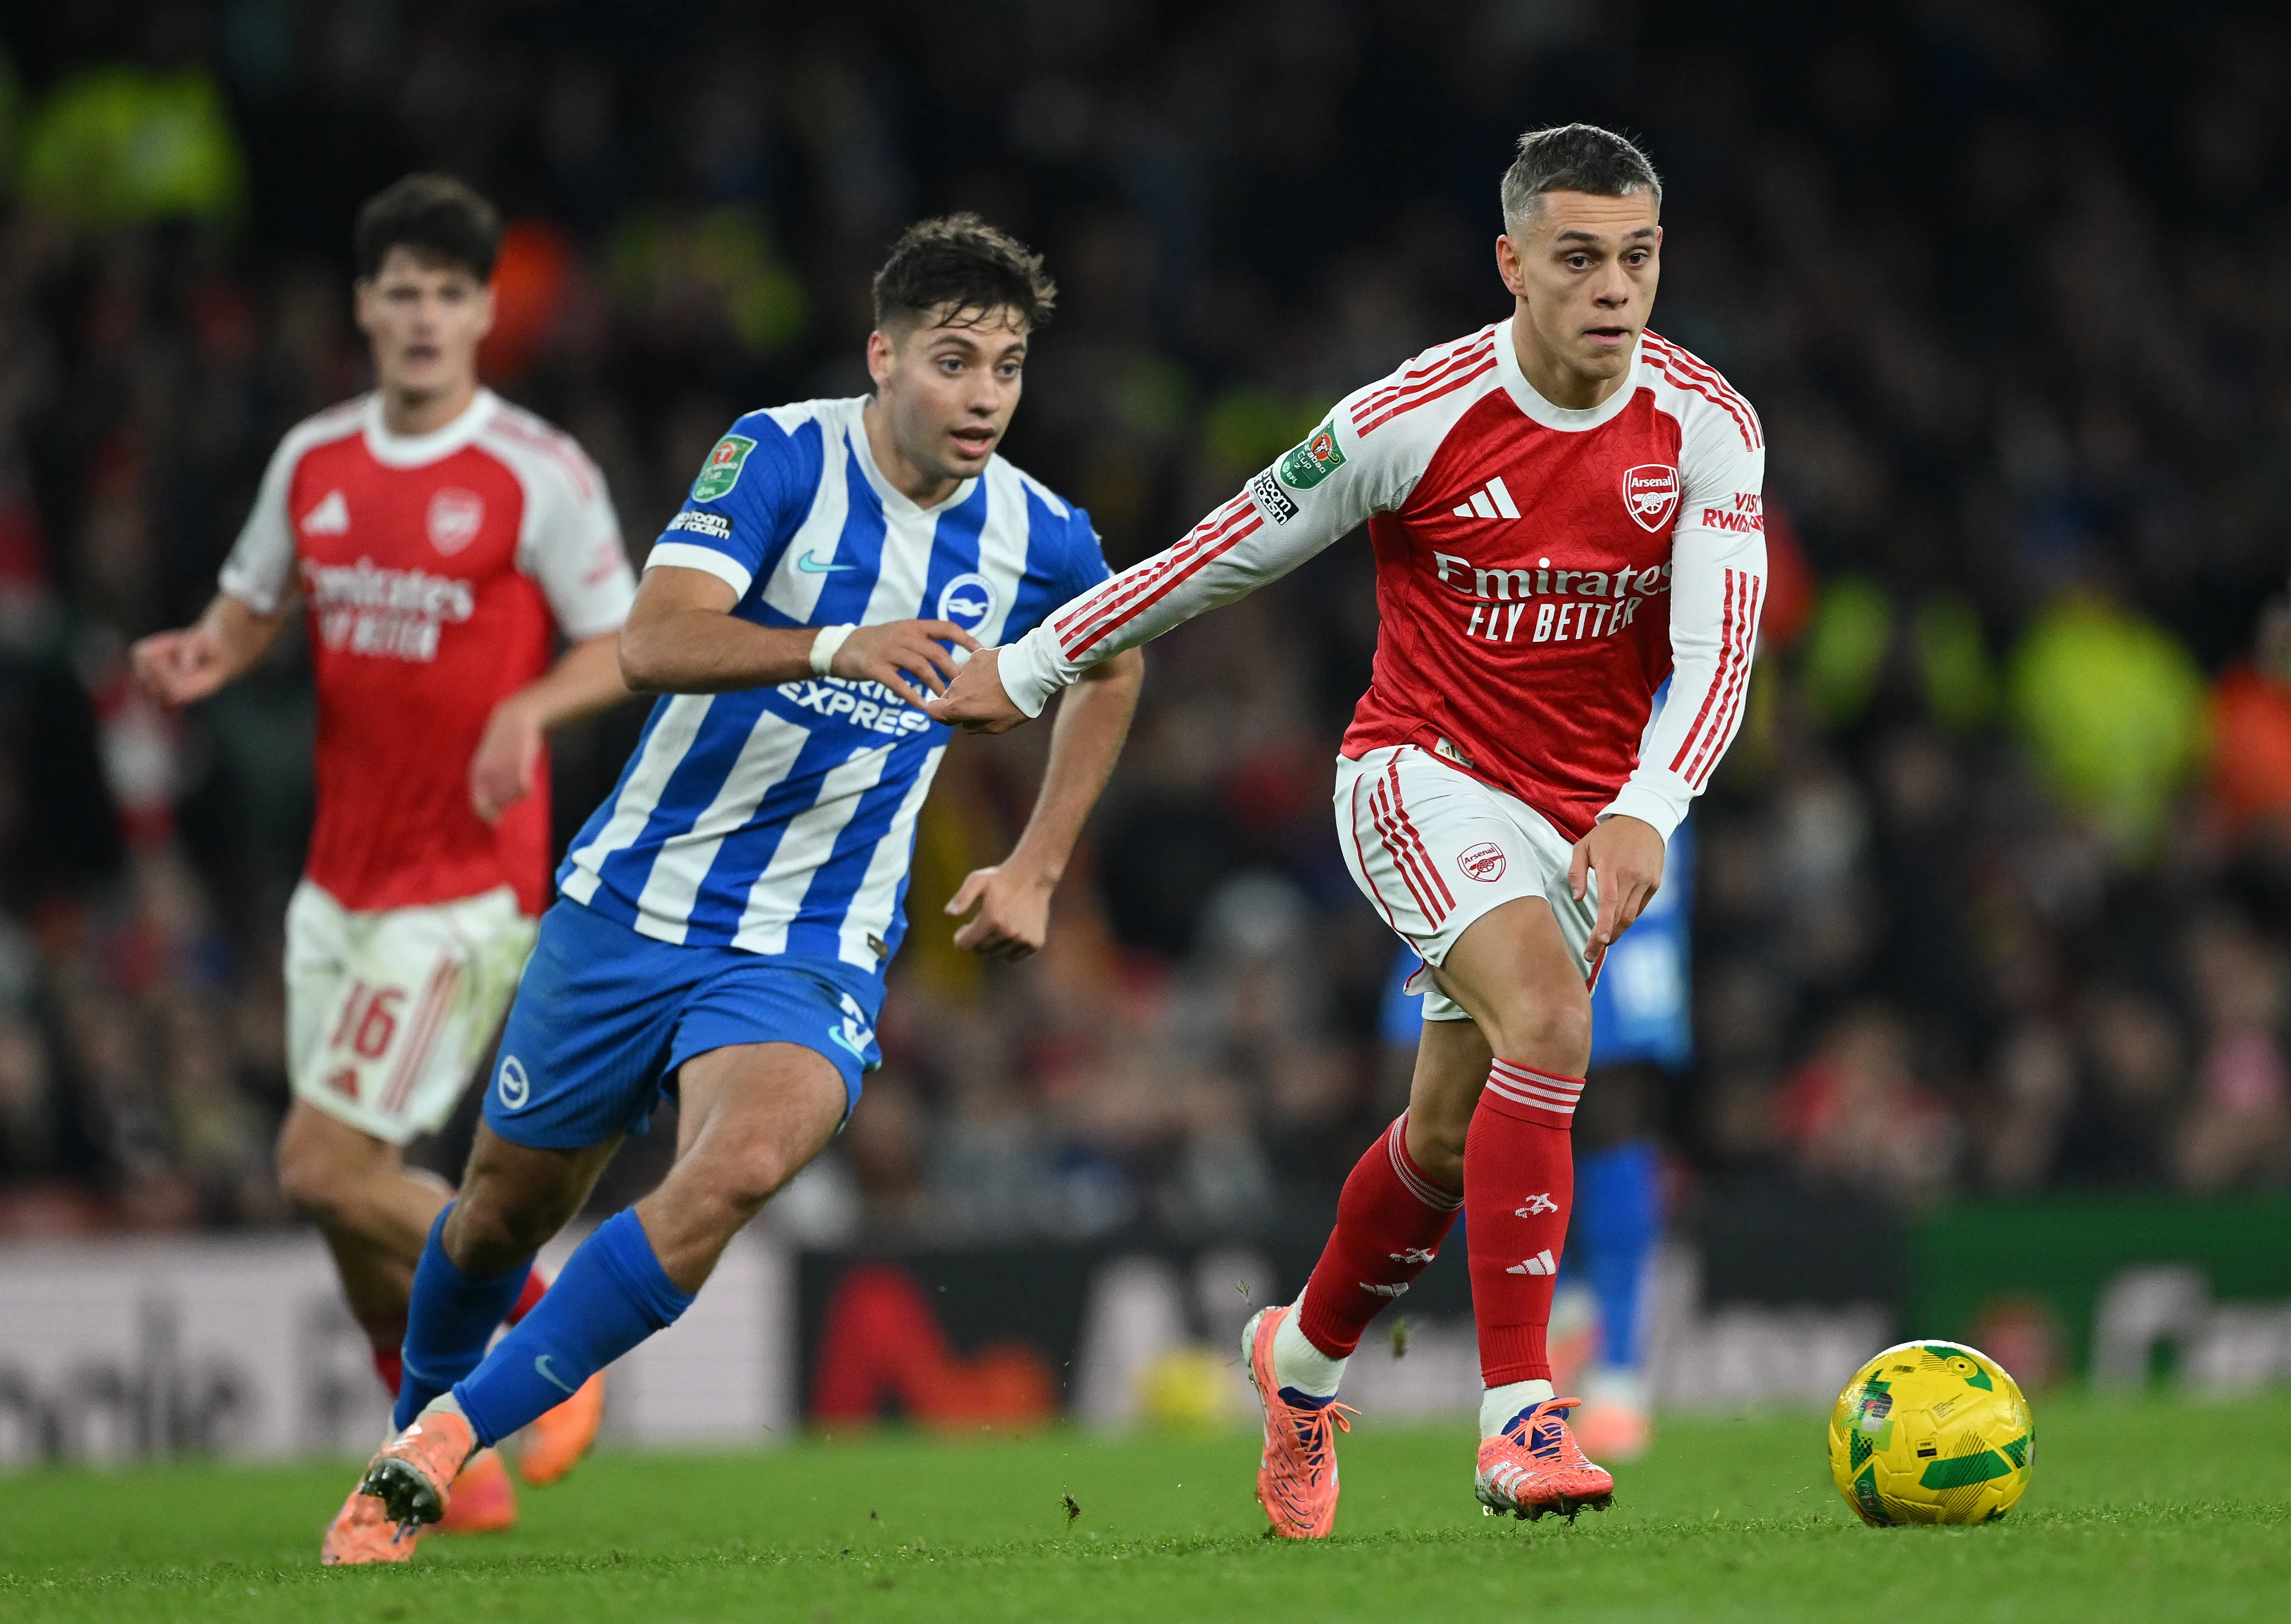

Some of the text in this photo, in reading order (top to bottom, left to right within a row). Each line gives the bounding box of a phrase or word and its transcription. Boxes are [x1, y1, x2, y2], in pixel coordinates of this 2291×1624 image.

[1297, 450, 1312, 469] Cup
[1305, 440, 1326, 474] arabao
[1263, 475, 1291, 512] room
[1286, 471, 1297, 484] EFL
[1631, 475, 1672, 488] Arsenal
[1254, 482, 1287, 525] racism
[1466, 597, 1643, 642] FLY BETTER
[1464, 847, 1496, 864] Arsenal
[332, 981, 406, 1059] 16
